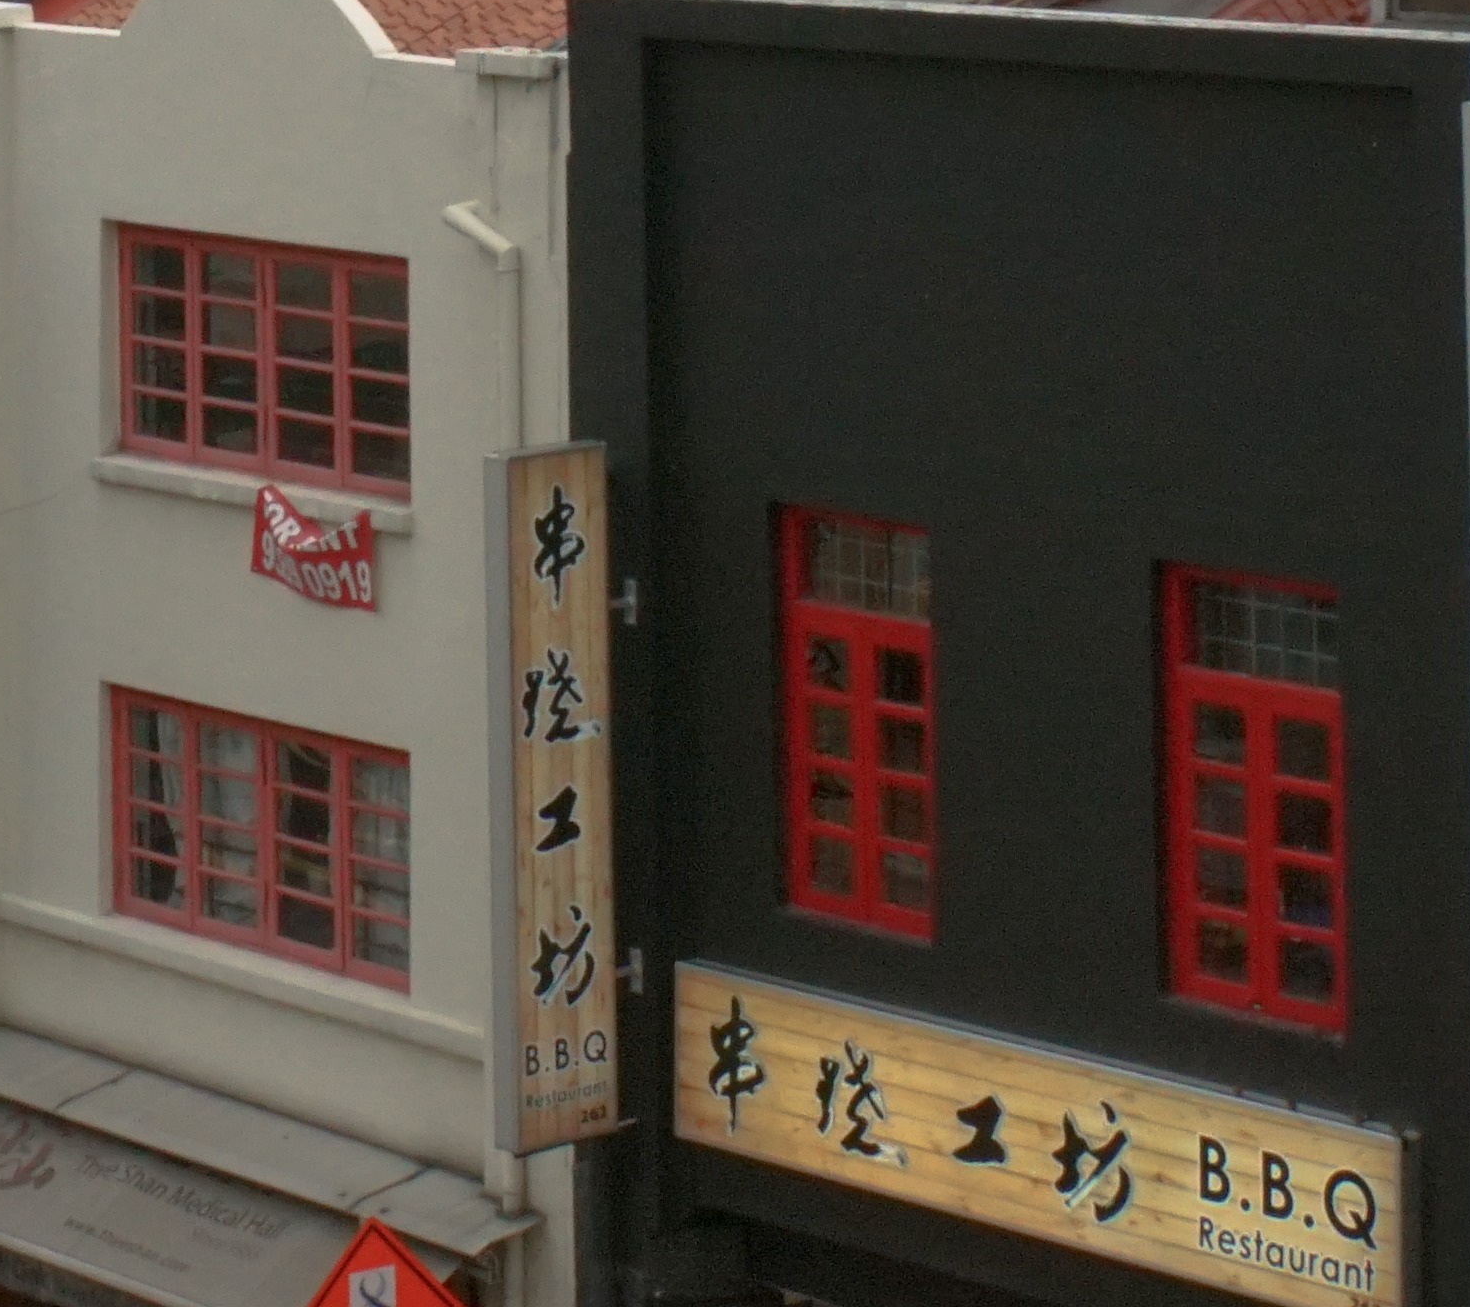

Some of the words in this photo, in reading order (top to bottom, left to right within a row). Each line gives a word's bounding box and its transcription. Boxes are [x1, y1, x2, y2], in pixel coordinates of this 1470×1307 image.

[524, 1029, 609, 1077] B.B.Q
[525, 1081, 608, 1109] Restaurant
[117, 1161, 170, 1200] Shan
[166, 1184, 250, 1228] Medical
[244, 1213, 292, 1241] Hall
[1197, 1133, 1379, 1250] B.B.Q
[1197, 1217, 1376, 1295] Restaurant
